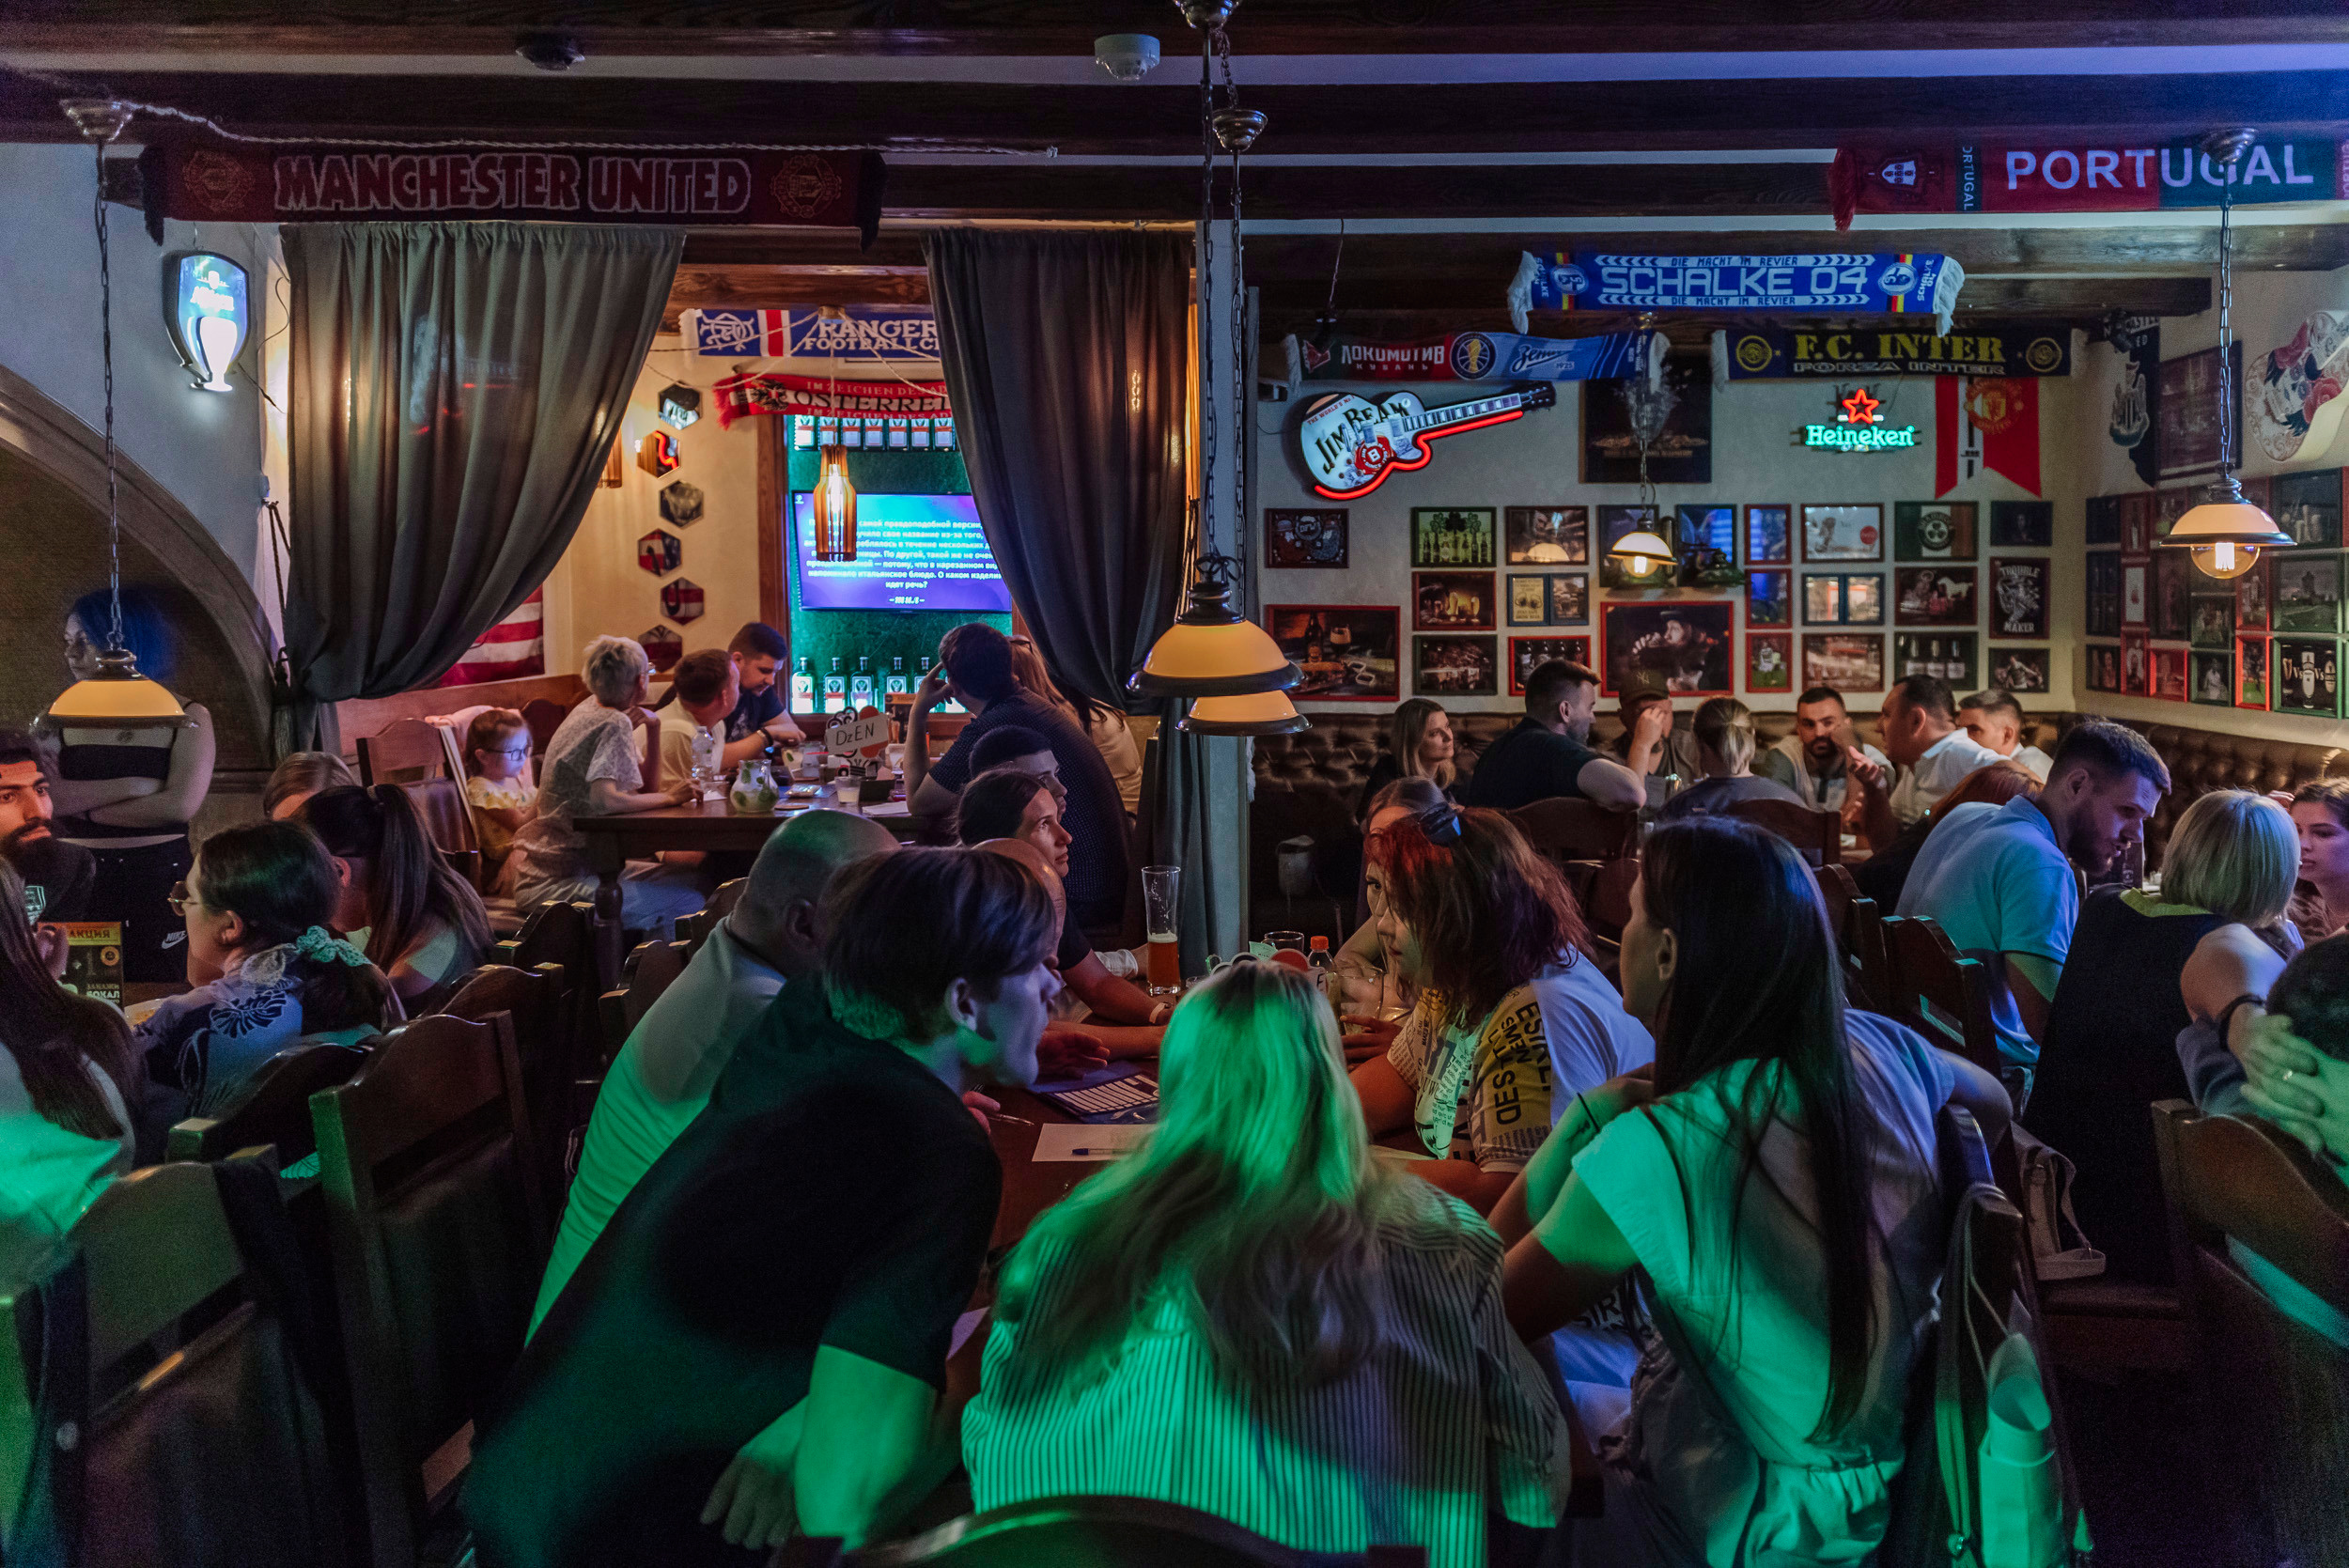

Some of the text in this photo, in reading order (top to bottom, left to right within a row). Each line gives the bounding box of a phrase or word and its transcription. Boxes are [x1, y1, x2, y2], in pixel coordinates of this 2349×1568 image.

[2006, 144, 2314, 190] PORTUGAL
[273, 152, 582, 211] MANCHESTER
[587, 158, 751, 213] UNITED
[1962, 146, 1975, 210] ORTUGAL
[1671, 256, 1798, 267] DIE MACHT IM REVIER
[1601, 266, 1868, 296] SCHALKE 04
[1671, 295, 1796, 305] DIE MACHT IM REVIER
[817, 318, 938, 338] RANGER
[1341, 345, 1445, 365] ЛОКОМОТИВ
[1795, 333, 2007, 363] F.C. INTER
[1794, 361, 2007, 376] FORZA INTER
[1315, 401, 1409, 475] JIM BEAM
[1805, 425, 1915, 446] Heineken
[165, 930, 187, 942] NIKE
